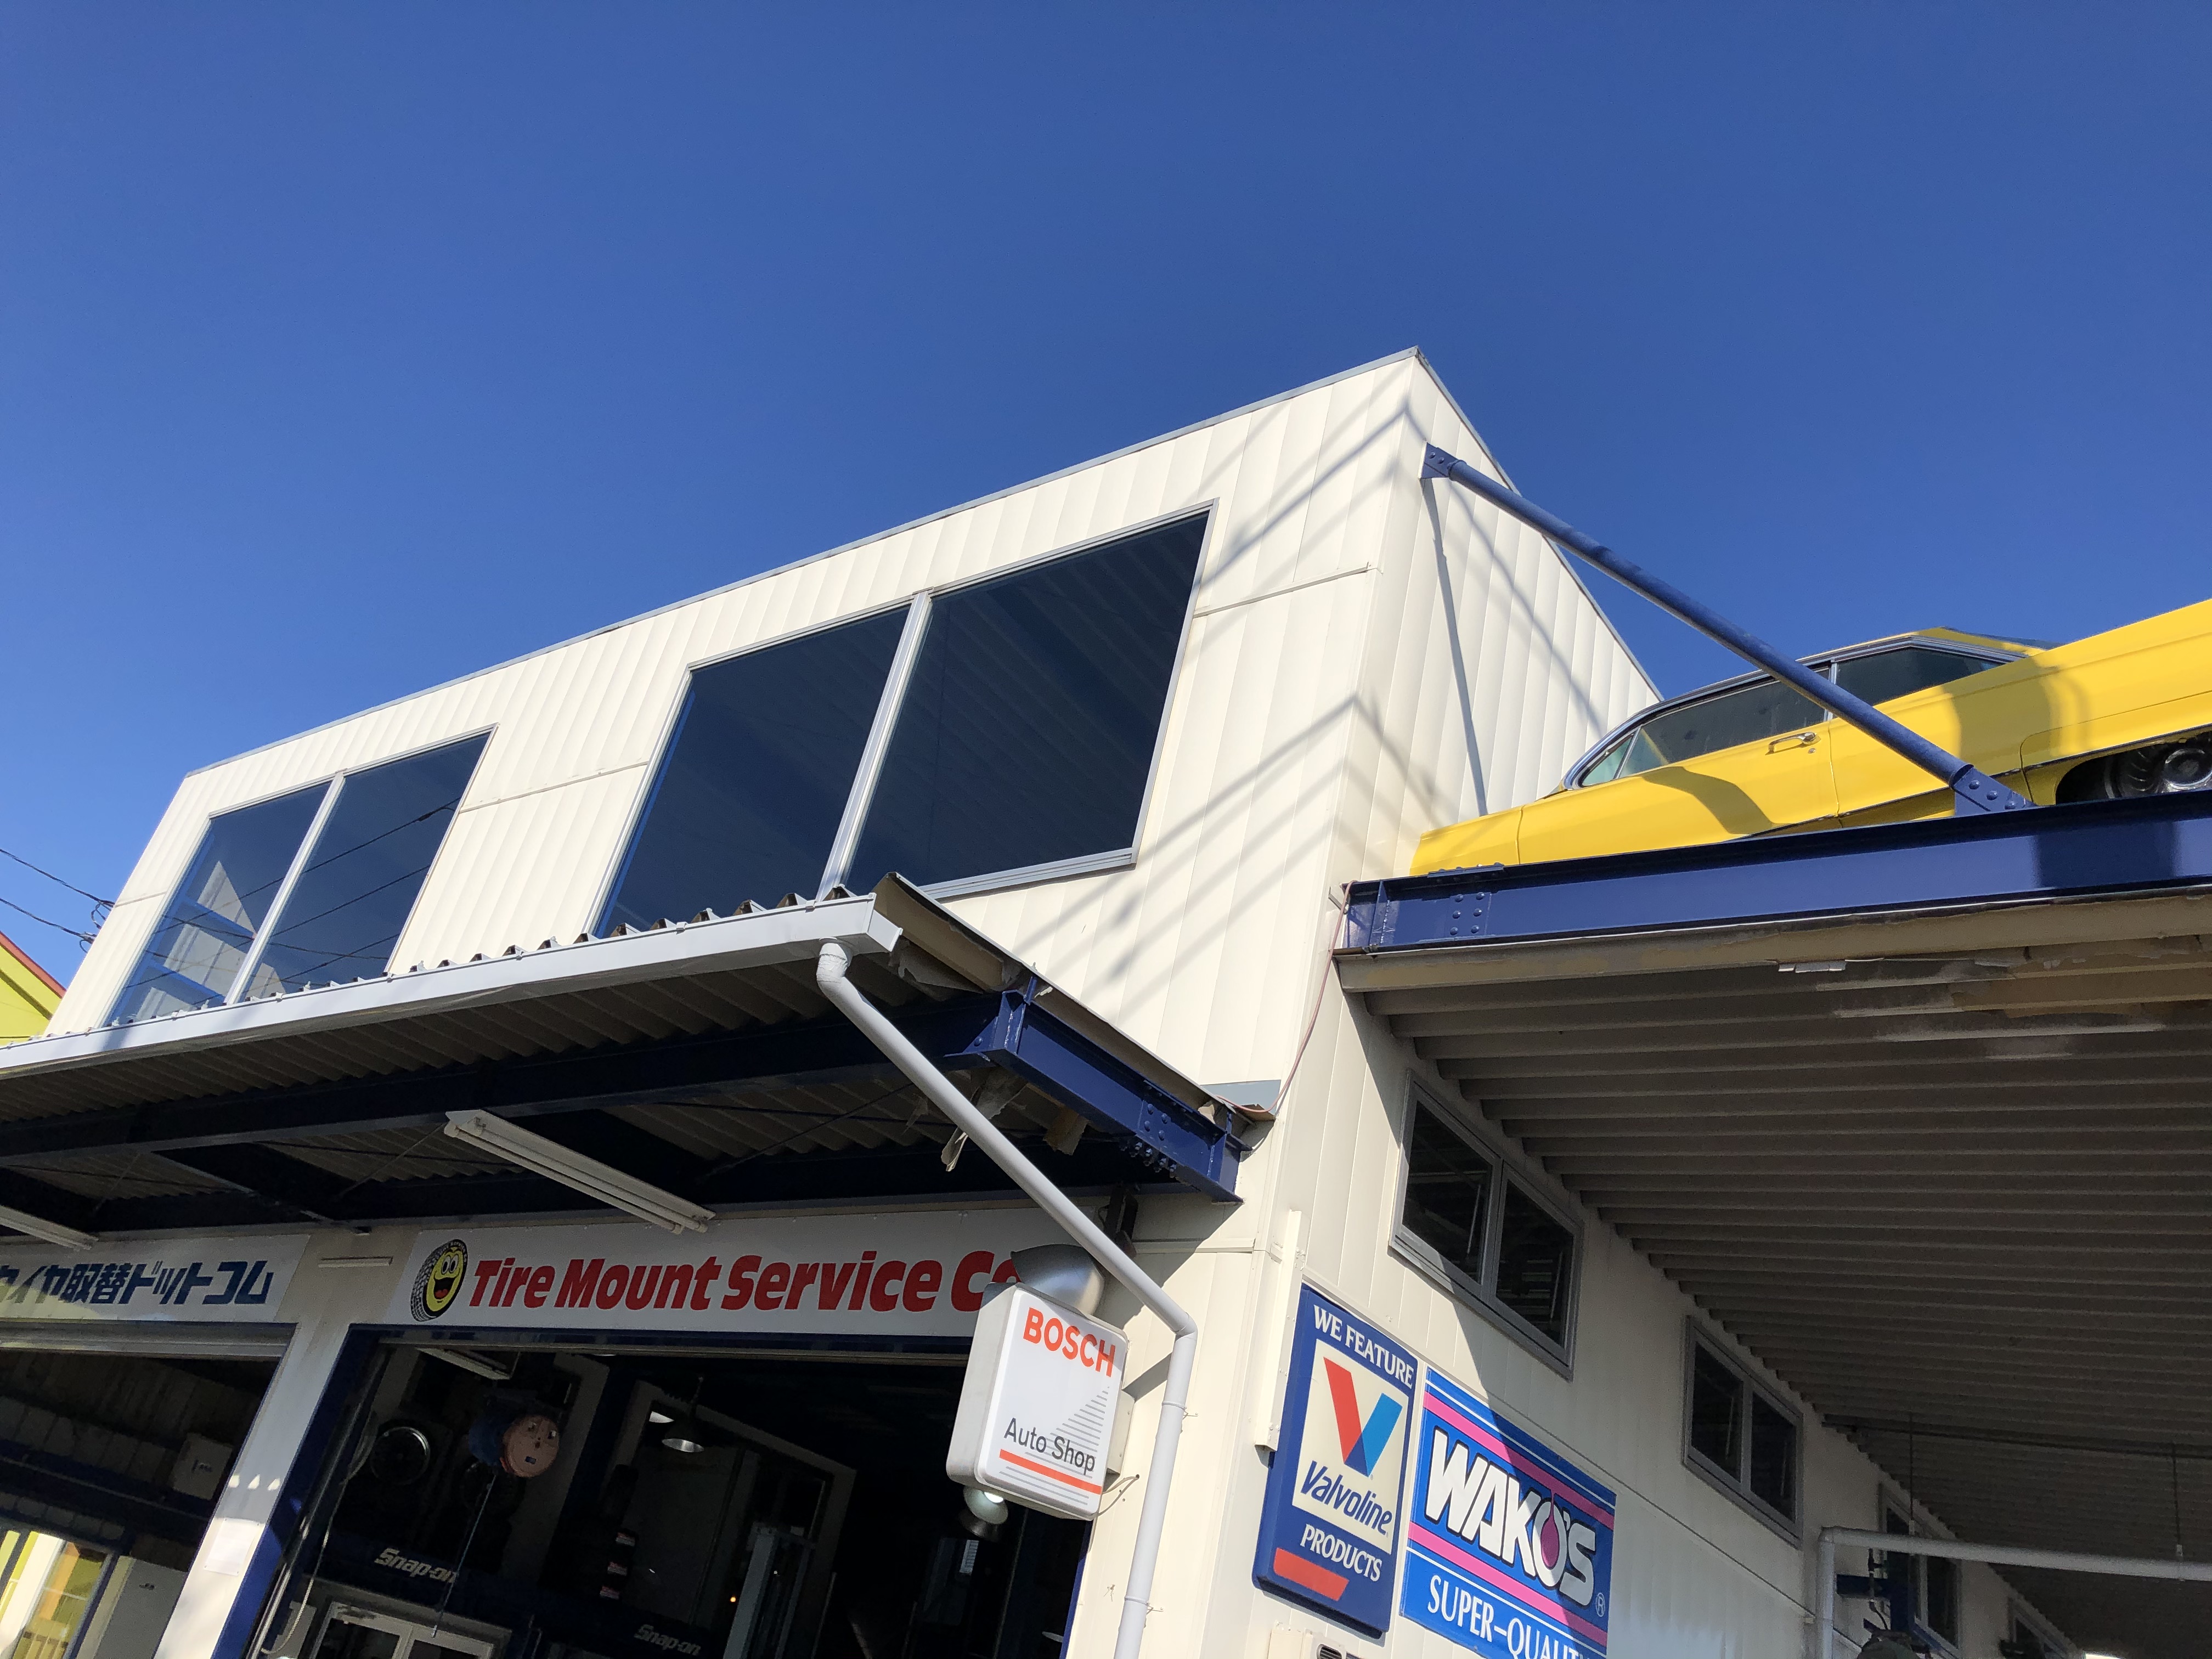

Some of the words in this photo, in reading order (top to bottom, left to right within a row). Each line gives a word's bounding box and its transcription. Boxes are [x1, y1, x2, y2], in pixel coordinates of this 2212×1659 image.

[469, 1257, 555, 1308] Tire
[554, 1256, 723, 1310] Mount
[720, 1250, 943, 1312] Service
[951, 1250, 1022, 1312] C
[1023, 1307, 1115, 1378] BOSCH
[1313, 1304, 1342, 1342] WE
[1345, 1324, 1414, 1390] FEATURE
[1003, 1417, 1047, 1453] Auto
[1051, 1435, 1095, 1475] Shop
[1300, 1460, 1393, 1536] Valvoline
[374, 1548, 457, 1584] Snap-on
[1300, 1523, 1383, 1582] PRODUCTS
[633, 1624, 702, 1656] Snap-on
